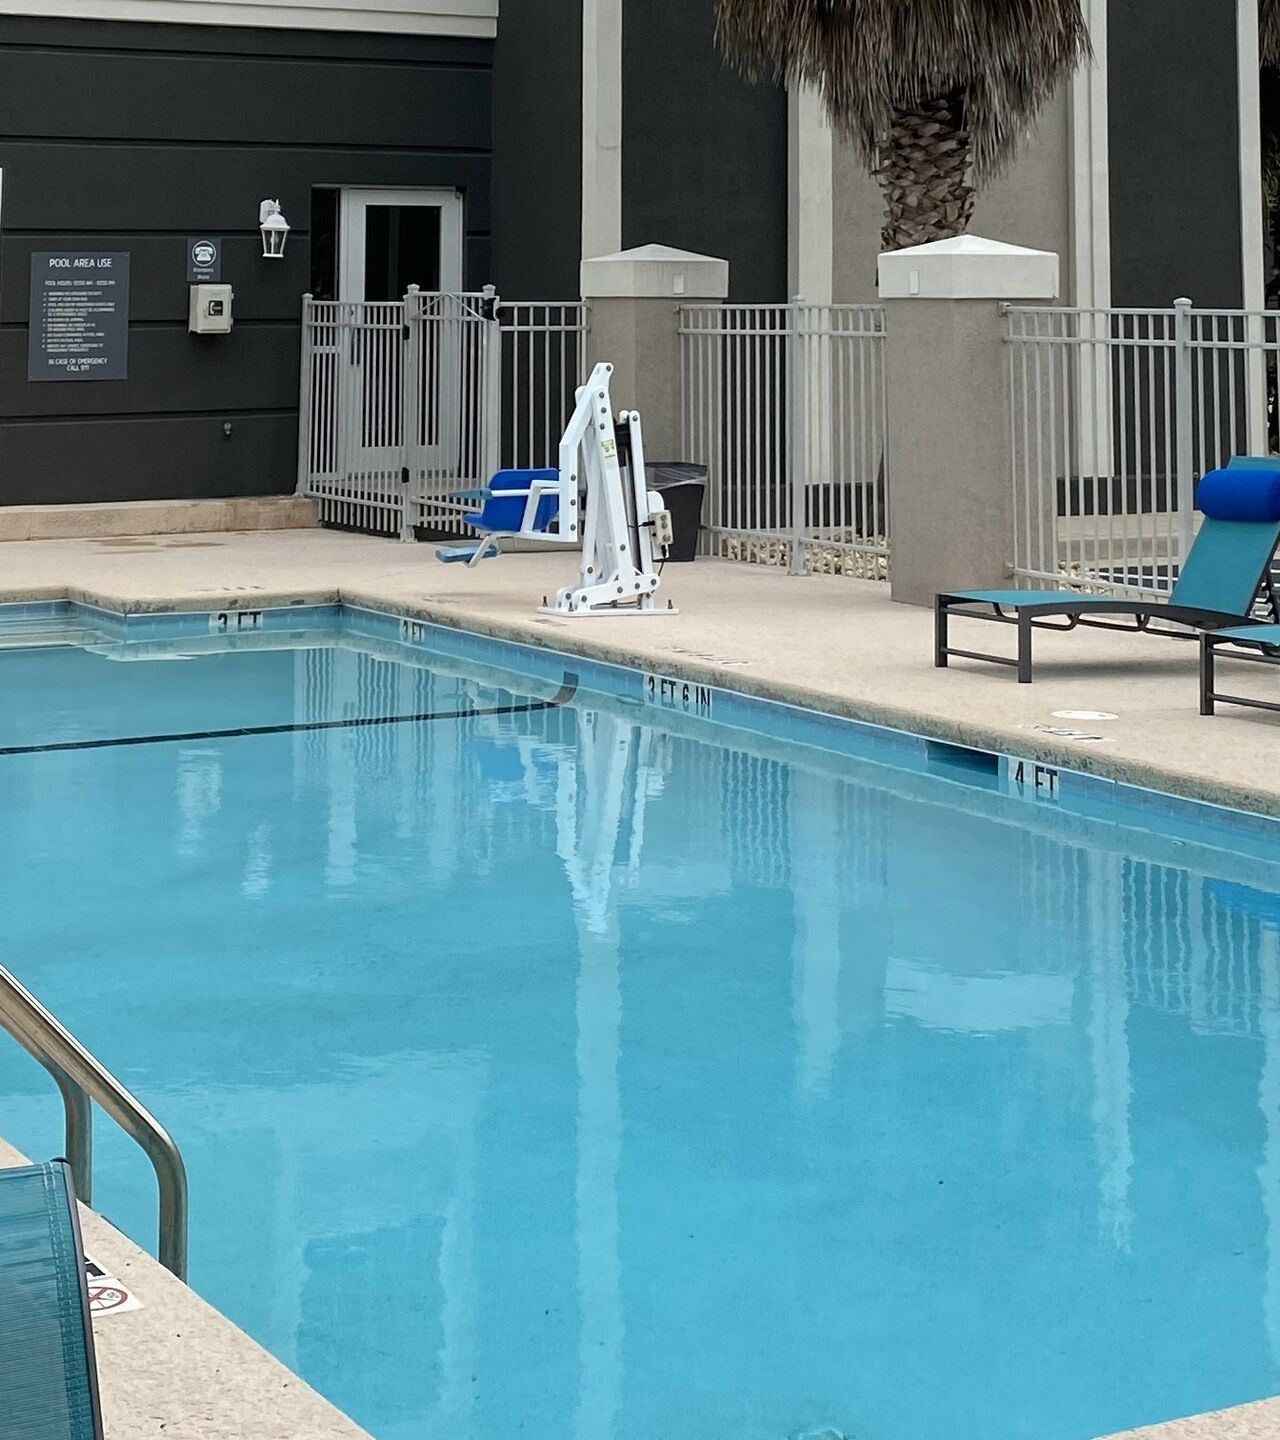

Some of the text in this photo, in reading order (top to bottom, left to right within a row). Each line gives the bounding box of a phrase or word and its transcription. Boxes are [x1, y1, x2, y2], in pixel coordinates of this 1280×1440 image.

[49, 257, 112, 268] POOL AREA USE
[660, 678, 677, 699] FT
[695, 685, 711, 707] IN
[1035, 765, 1058, 792] FT
